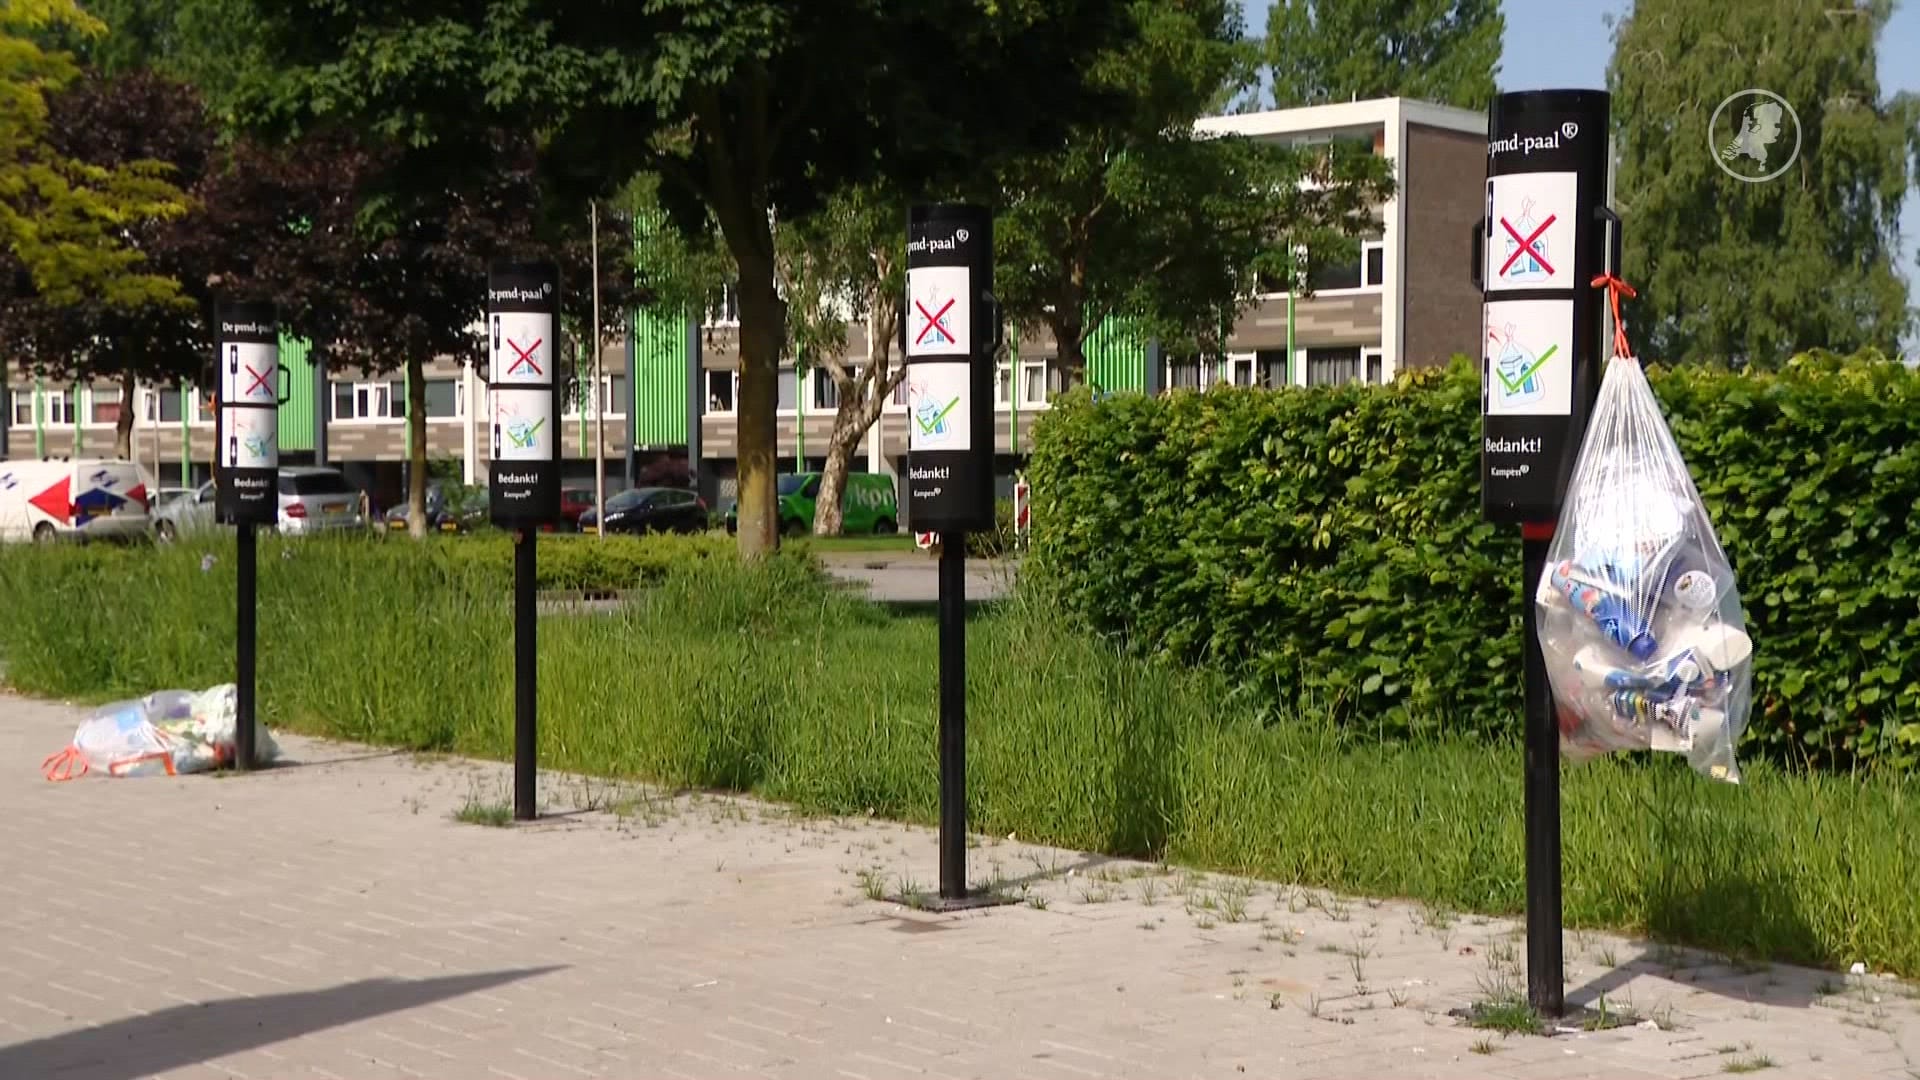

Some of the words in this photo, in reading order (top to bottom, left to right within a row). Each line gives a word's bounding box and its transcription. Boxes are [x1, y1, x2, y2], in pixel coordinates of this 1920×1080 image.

[1491, 131, 1559, 158] pmd-paal
[907, 235, 955, 256] pmd-paal
[496, 286, 543, 303] pmd-paal
[1485, 436, 1542, 453] Bedankt!
[498, 472, 538, 484] Bedankt!
